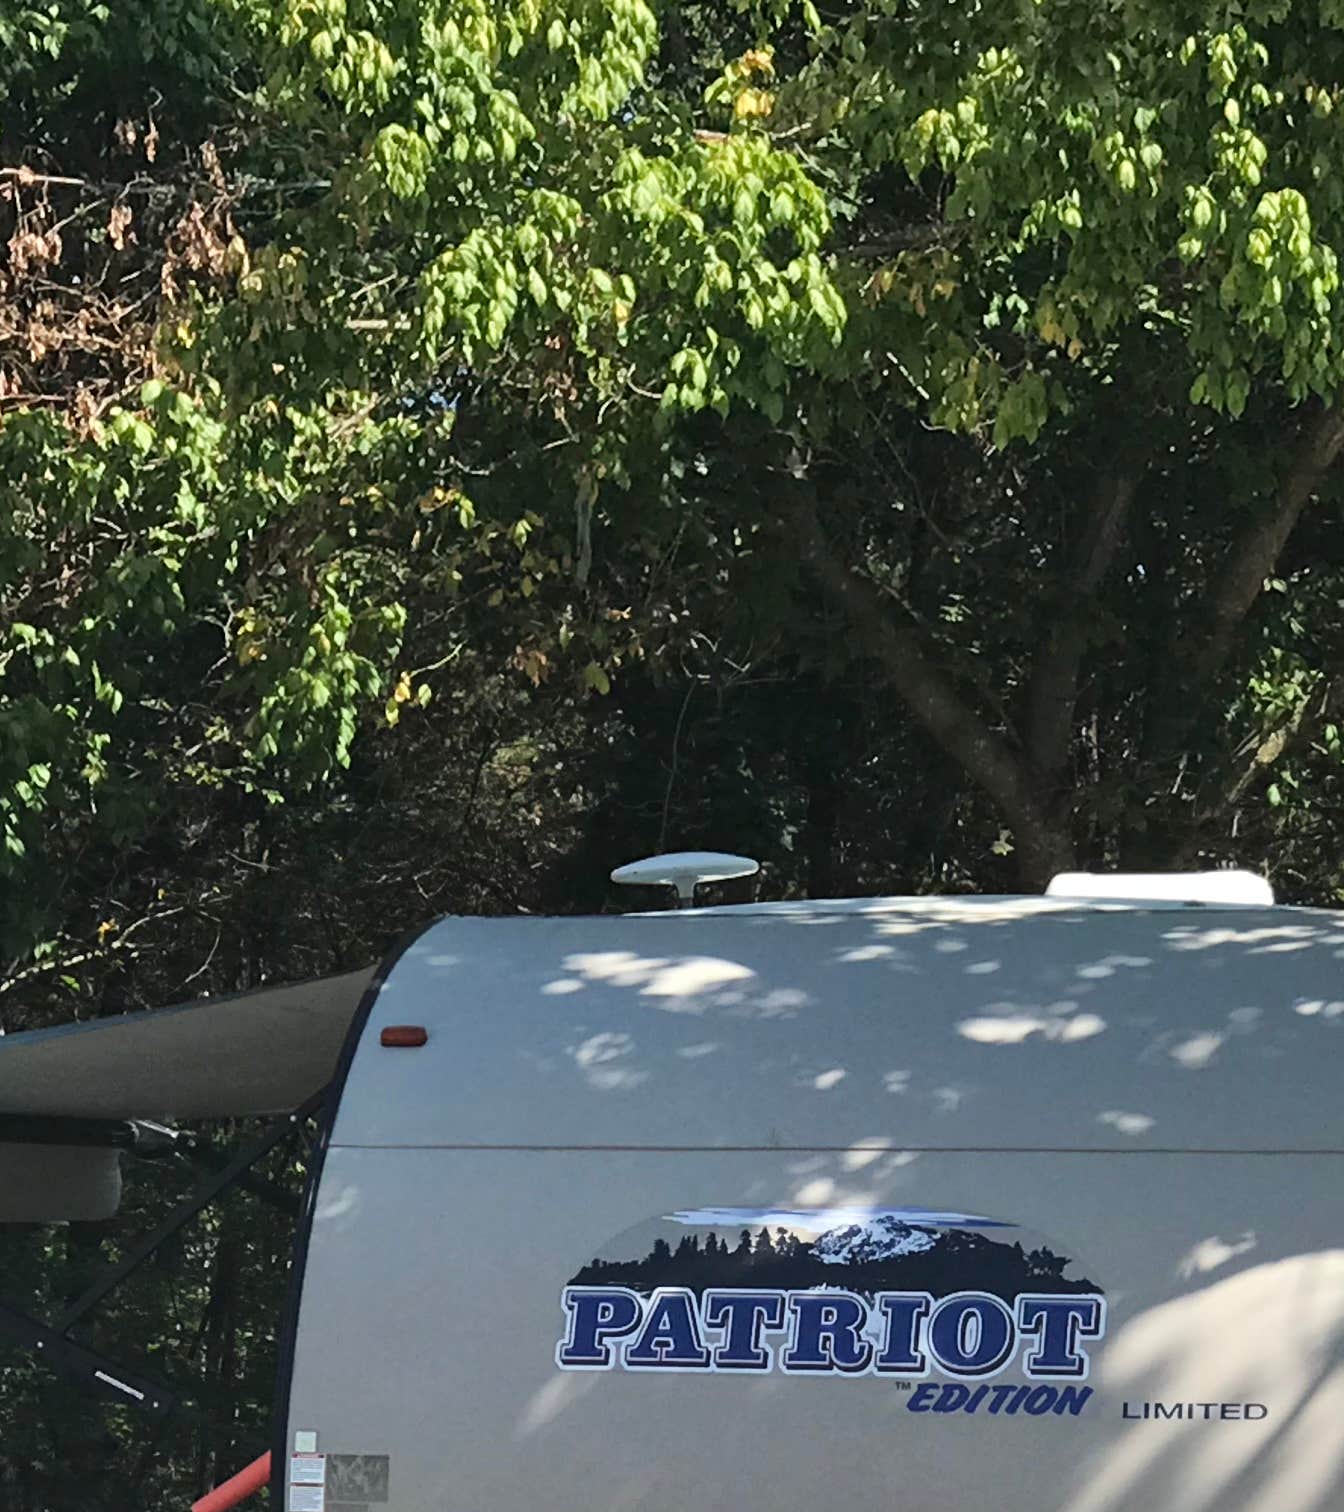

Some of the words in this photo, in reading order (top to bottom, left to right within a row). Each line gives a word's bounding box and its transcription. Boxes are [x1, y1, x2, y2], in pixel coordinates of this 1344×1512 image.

[556, 1286, 1106, 1380] PATRIOT
[907, 1382, 1094, 1416] EDITION
[1121, 1401, 1269, 1420] LIMITED
